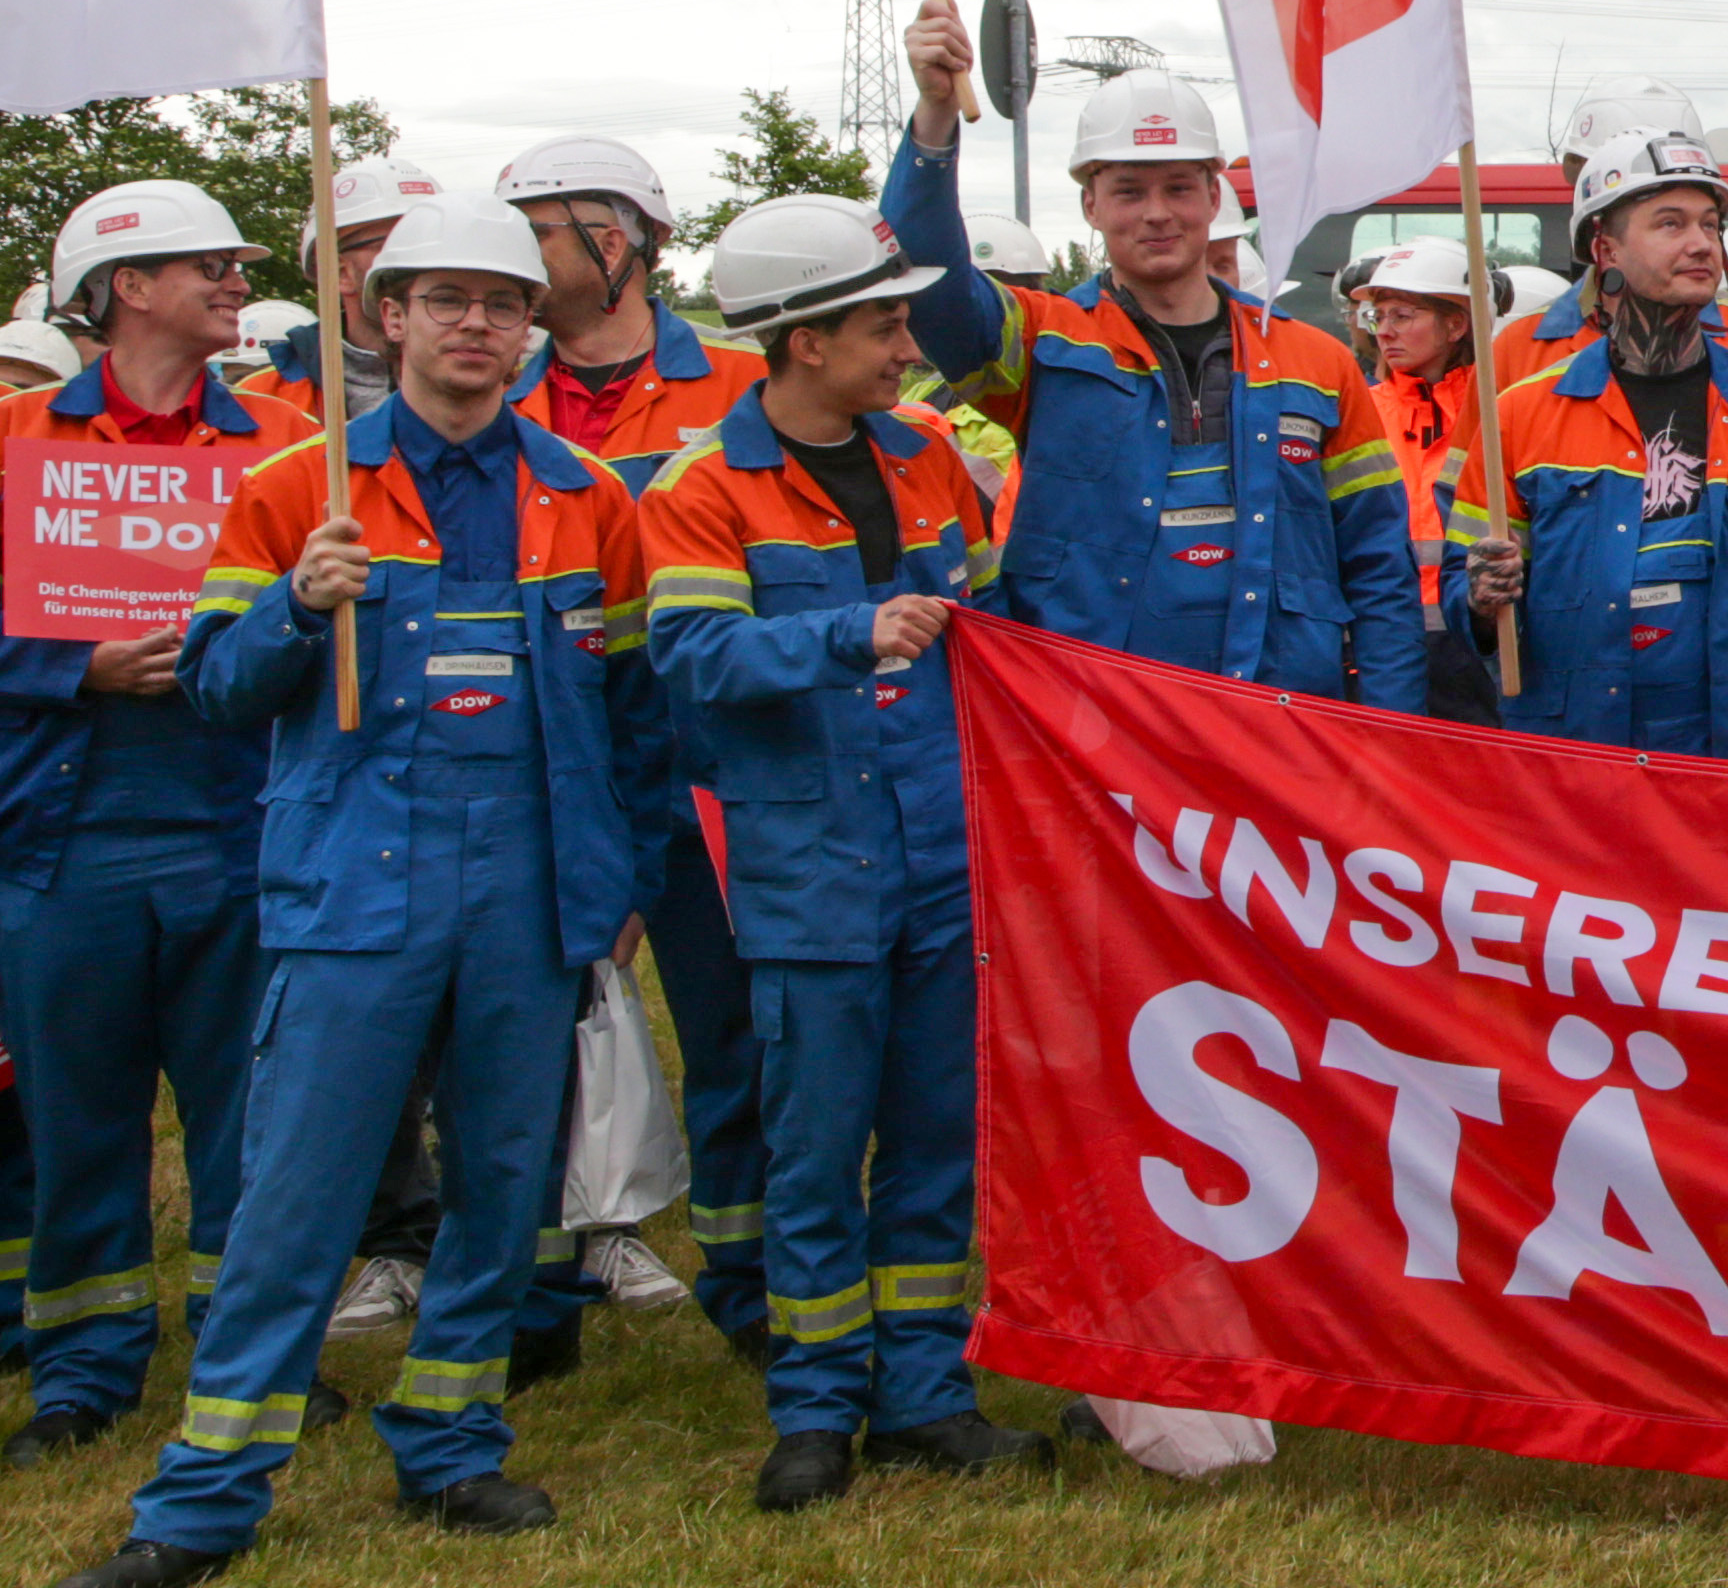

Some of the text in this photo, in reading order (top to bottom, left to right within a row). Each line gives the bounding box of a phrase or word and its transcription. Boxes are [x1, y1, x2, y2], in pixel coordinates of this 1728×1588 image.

[43, 460, 188, 504] NEVER
[34, 506, 99, 548] ME
[39, 582, 65, 597] Die
[44, 601, 69, 615] für
[72, 606, 124, 619] unsere
[129, 607, 177, 621] starke
